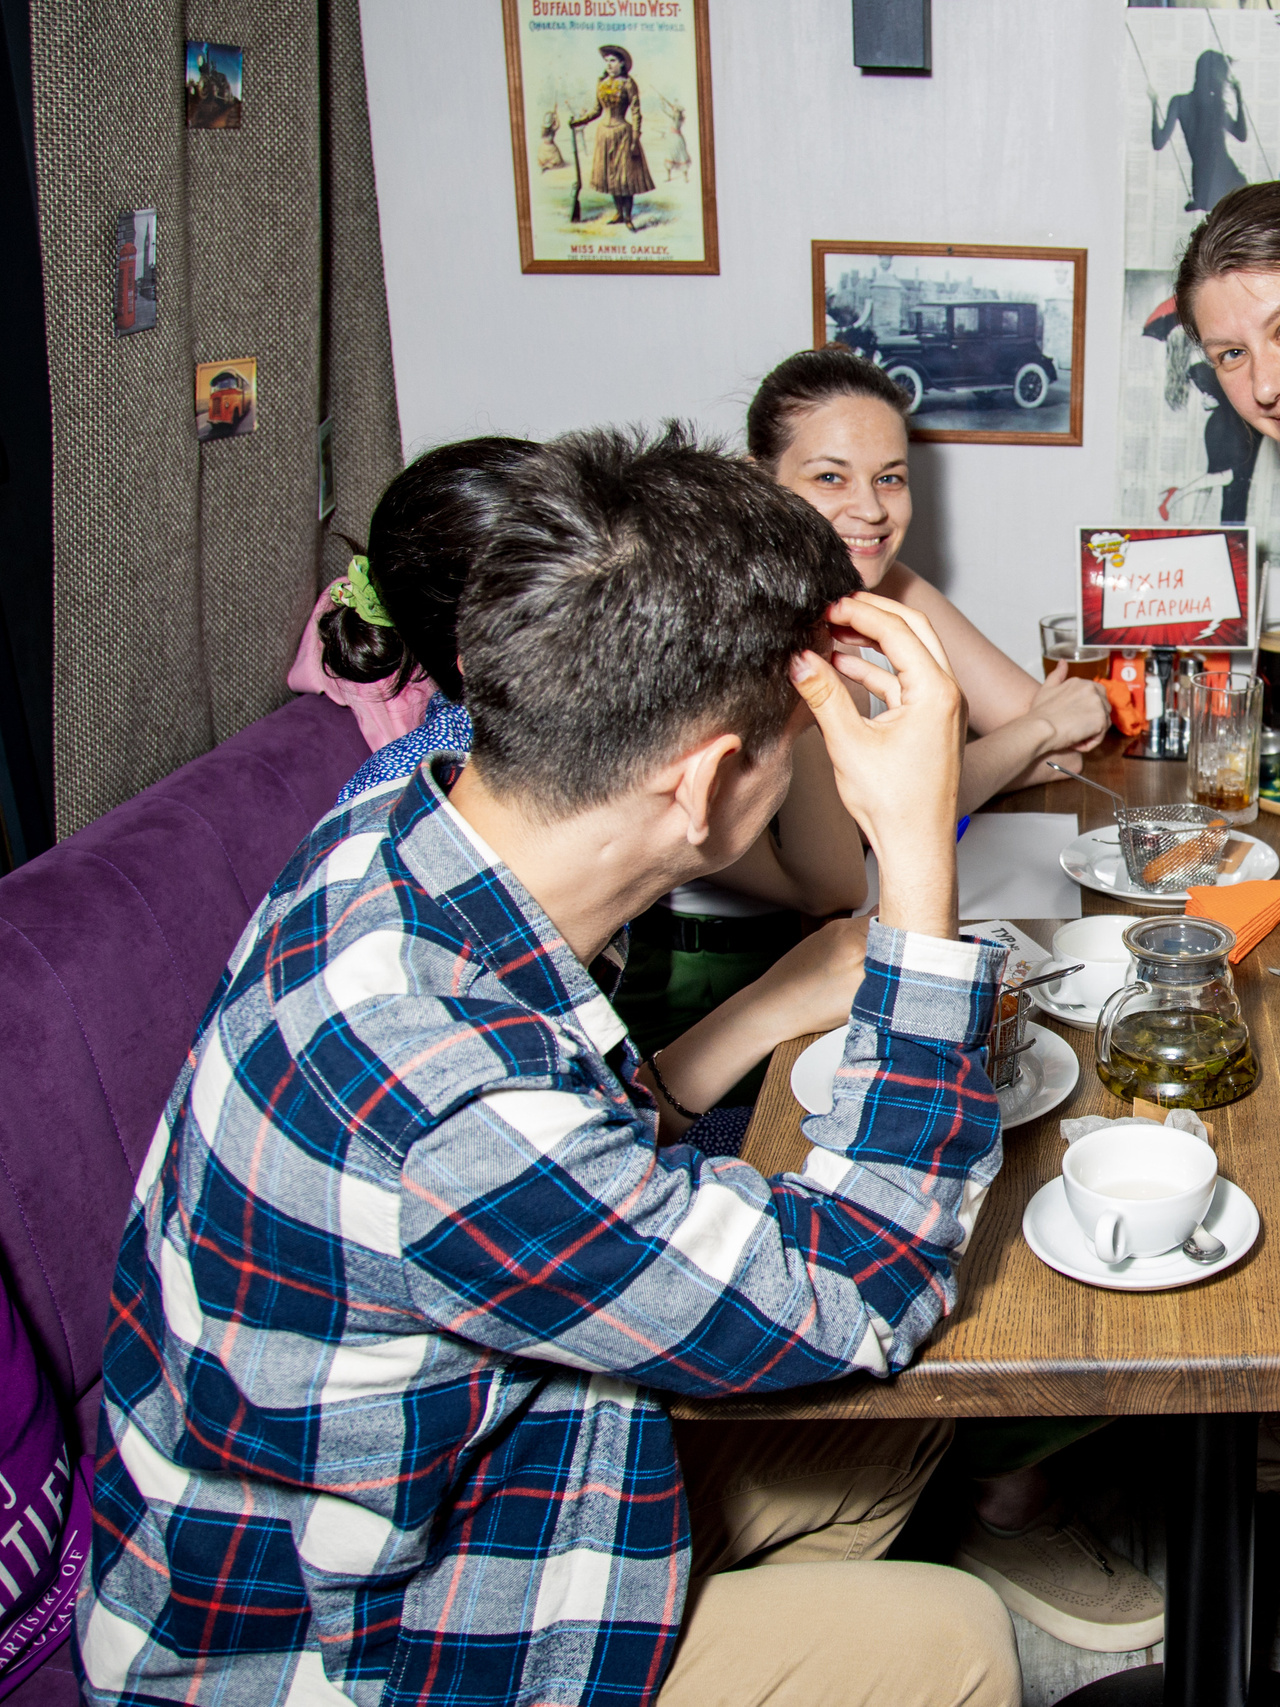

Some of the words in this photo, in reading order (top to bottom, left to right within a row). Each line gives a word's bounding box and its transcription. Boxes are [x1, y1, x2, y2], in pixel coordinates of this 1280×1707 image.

[532, 0, 581, 16] BUFFALO
[584, 0, 617, 16] BILL'S
[617, 0, 647, 17] WILD
[570, 245, 594, 254] MISS
[598, 245, 628, 255] ANNIE
[1123, 596, 1212, 619] ГАГАРИНА
[61, 1549, 84, 1577] OF
